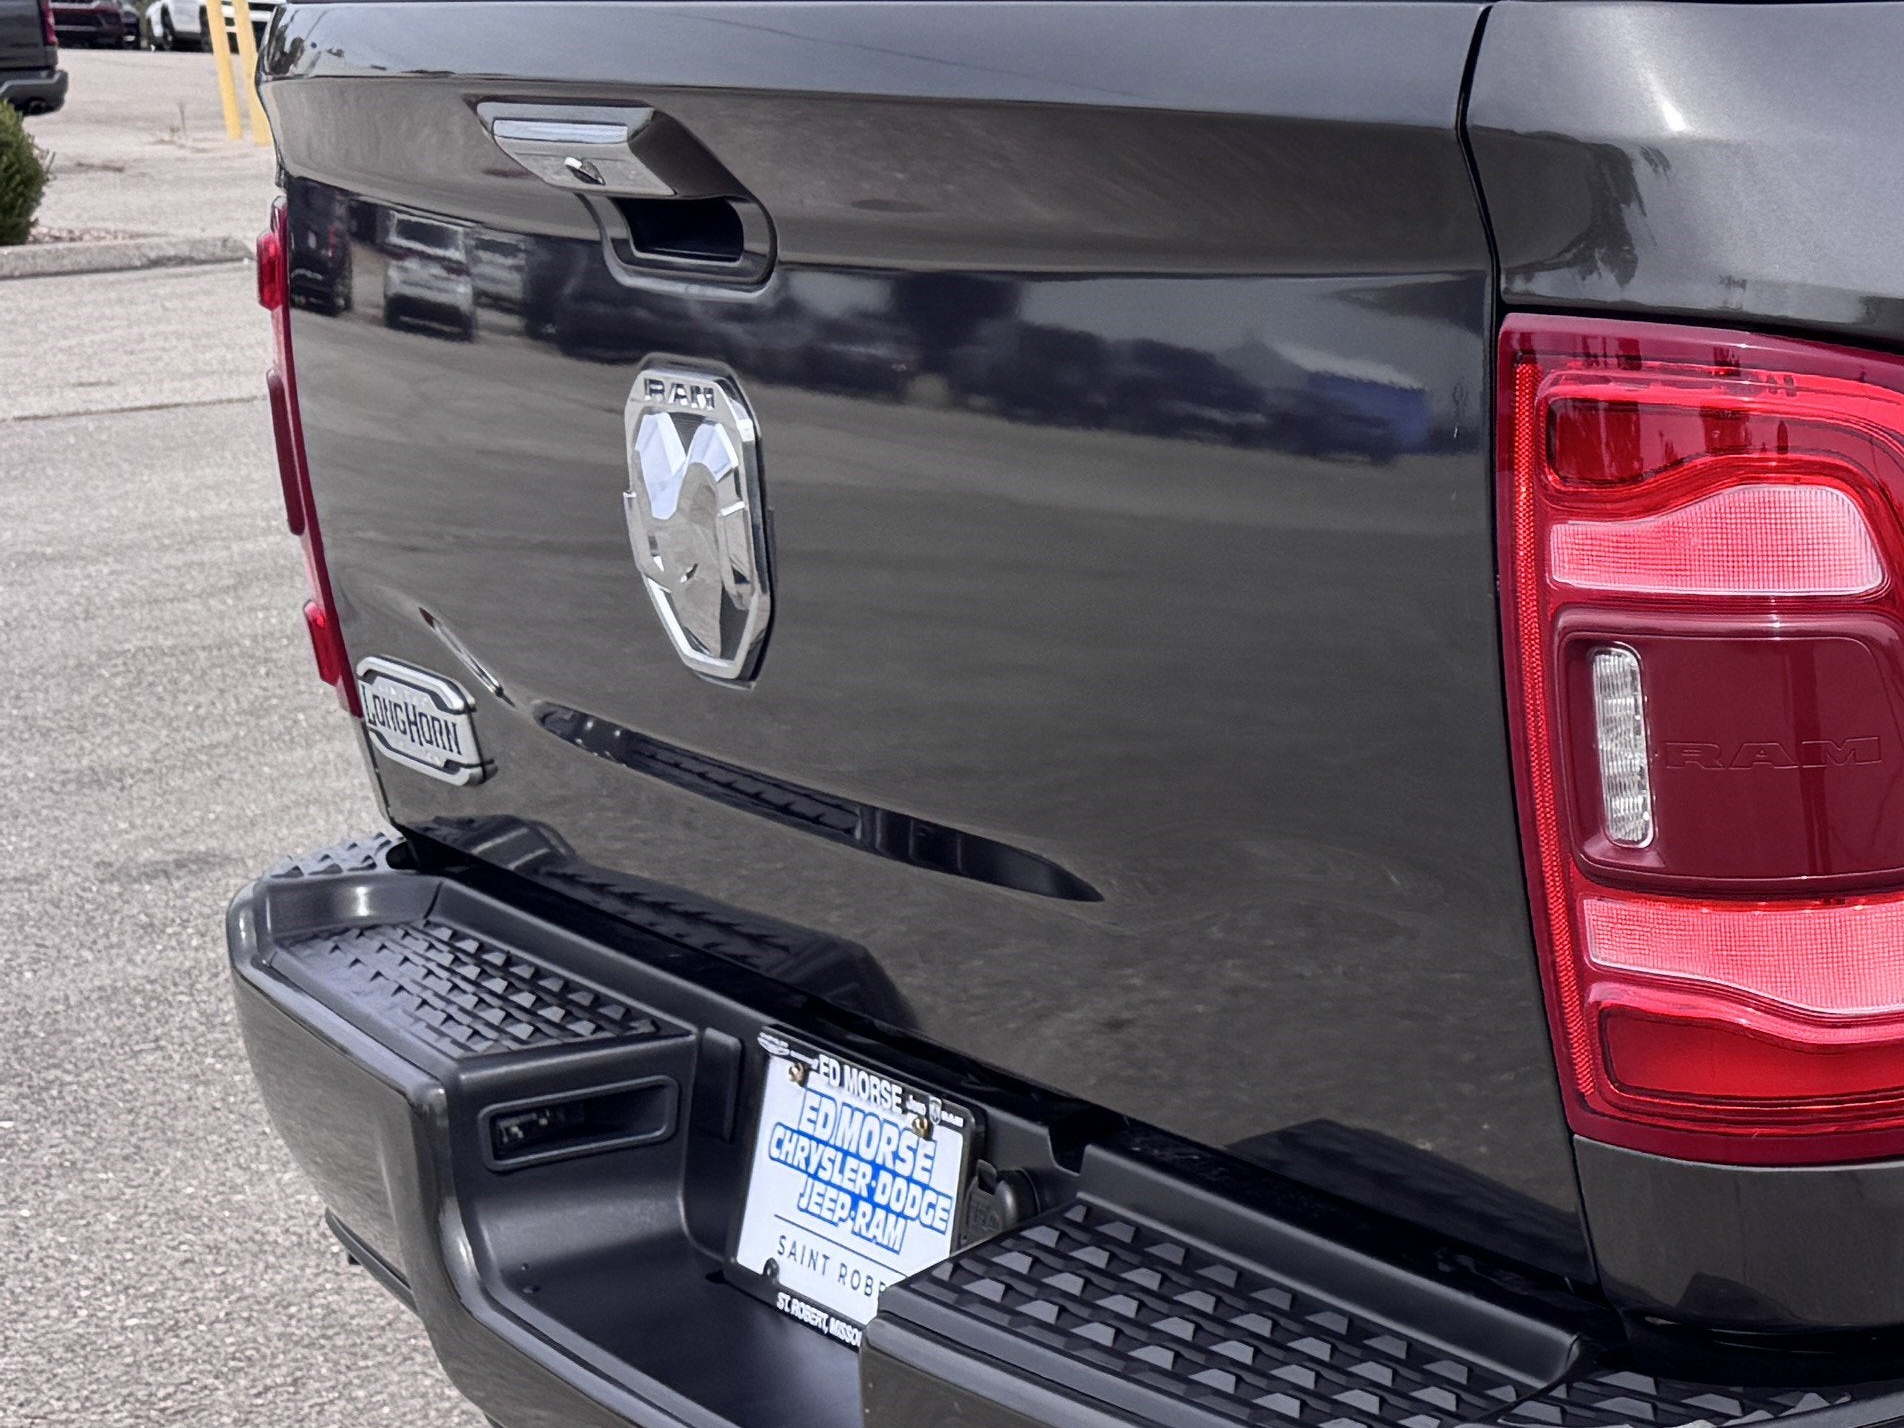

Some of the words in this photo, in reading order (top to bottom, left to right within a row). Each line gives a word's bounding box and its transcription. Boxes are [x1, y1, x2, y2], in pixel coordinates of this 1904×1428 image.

[643, 377, 716, 411] RAM
[361, 684, 463, 756] LONGHORN
[1665, 736, 1882, 770] RAM
[819, 1054, 841, 1088] ED
[843, 1064, 903, 1115] MORSE
[799, 1088, 838, 1144] ED
[835, 1102, 937, 1189] MORSE
[777, 1234, 830, 1276] SAINT
